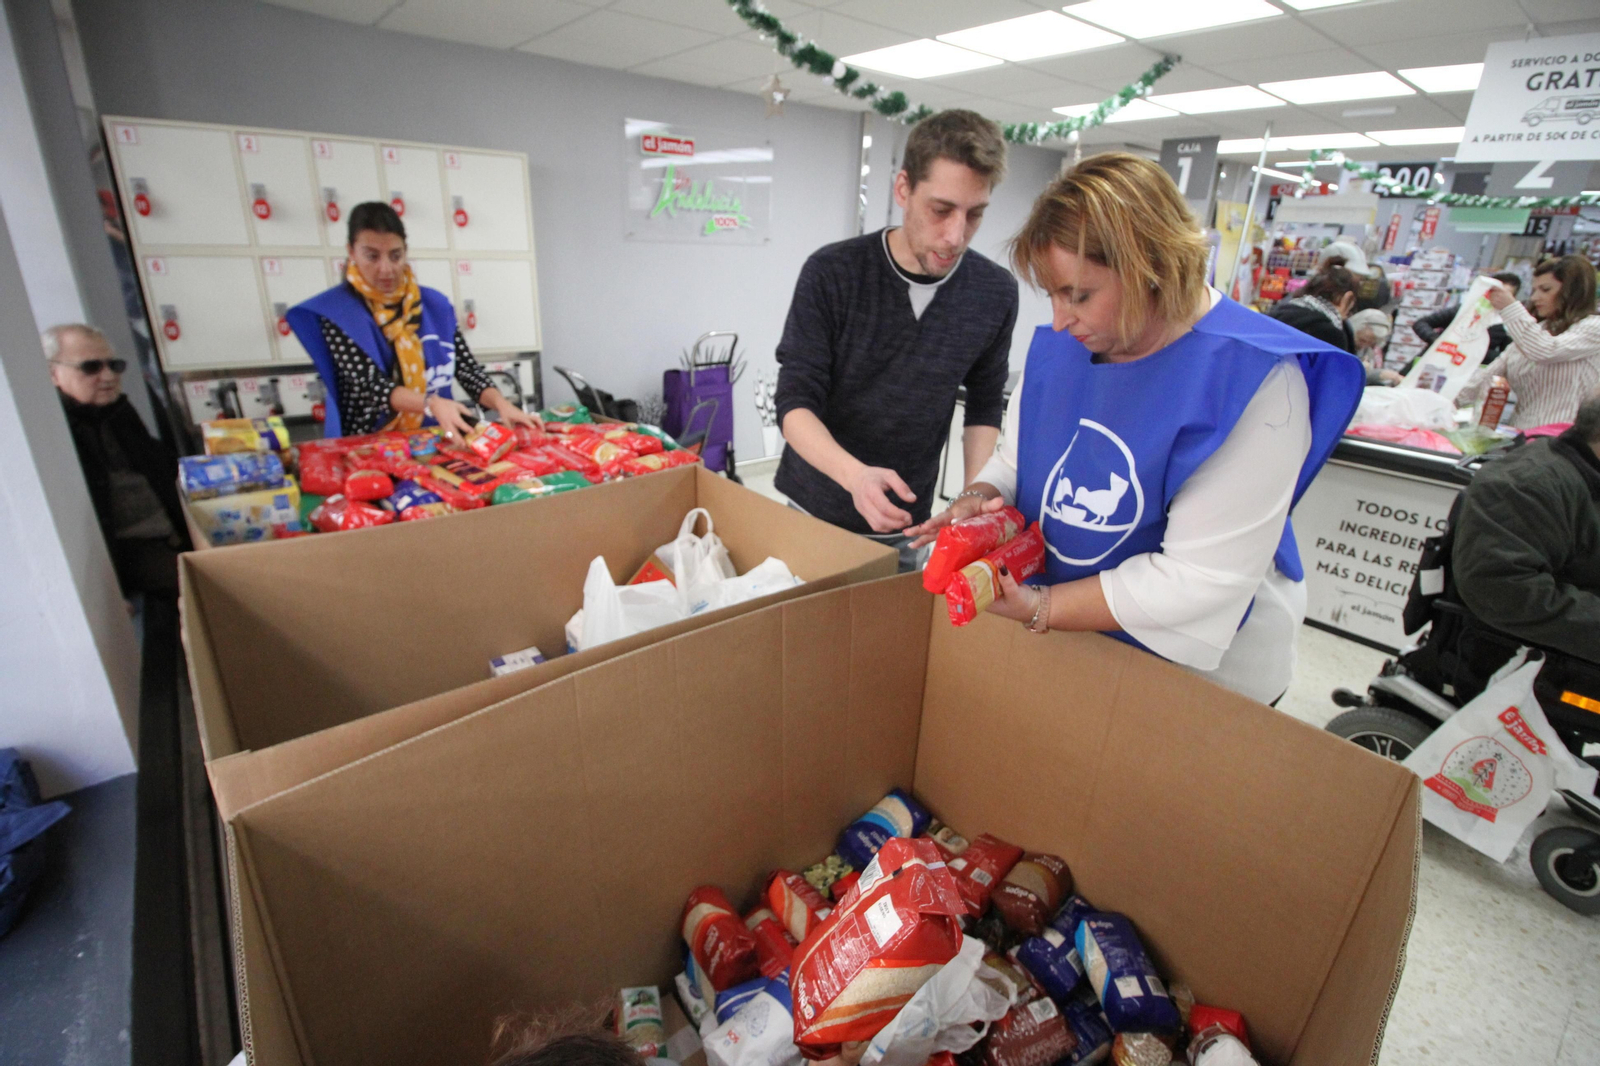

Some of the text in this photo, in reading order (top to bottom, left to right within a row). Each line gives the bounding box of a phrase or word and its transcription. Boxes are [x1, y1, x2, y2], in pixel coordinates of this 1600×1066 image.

[1510, 55, 1567, 69] SERVICIO
[1570, 54, 1579, 64] A
[1526, 67, 1600, 91] GRAT
[122, 129, 131, 140] 1
[1471, 134, 1479, 142] A
[1482, 132, 1523, 142] PARTIR
[1526, 131, 1541, 141] DE
[1570, 130, 1587, 140] DE
[244, 138, 253, 149] 2
[643, 135, 656, 149] el
[1177, 142, 1202, 154] CAJA
[1177, 157, 1193, 195] 1
[713, 216, 738, 228] 100%
[1356, 499, 1419, 525] TODOS
[1315, 537, 1356, 558] PARA
[1362, 550, 1393, 568] LAS
[1316, 561, 1408, 597] MÁS DELICI
